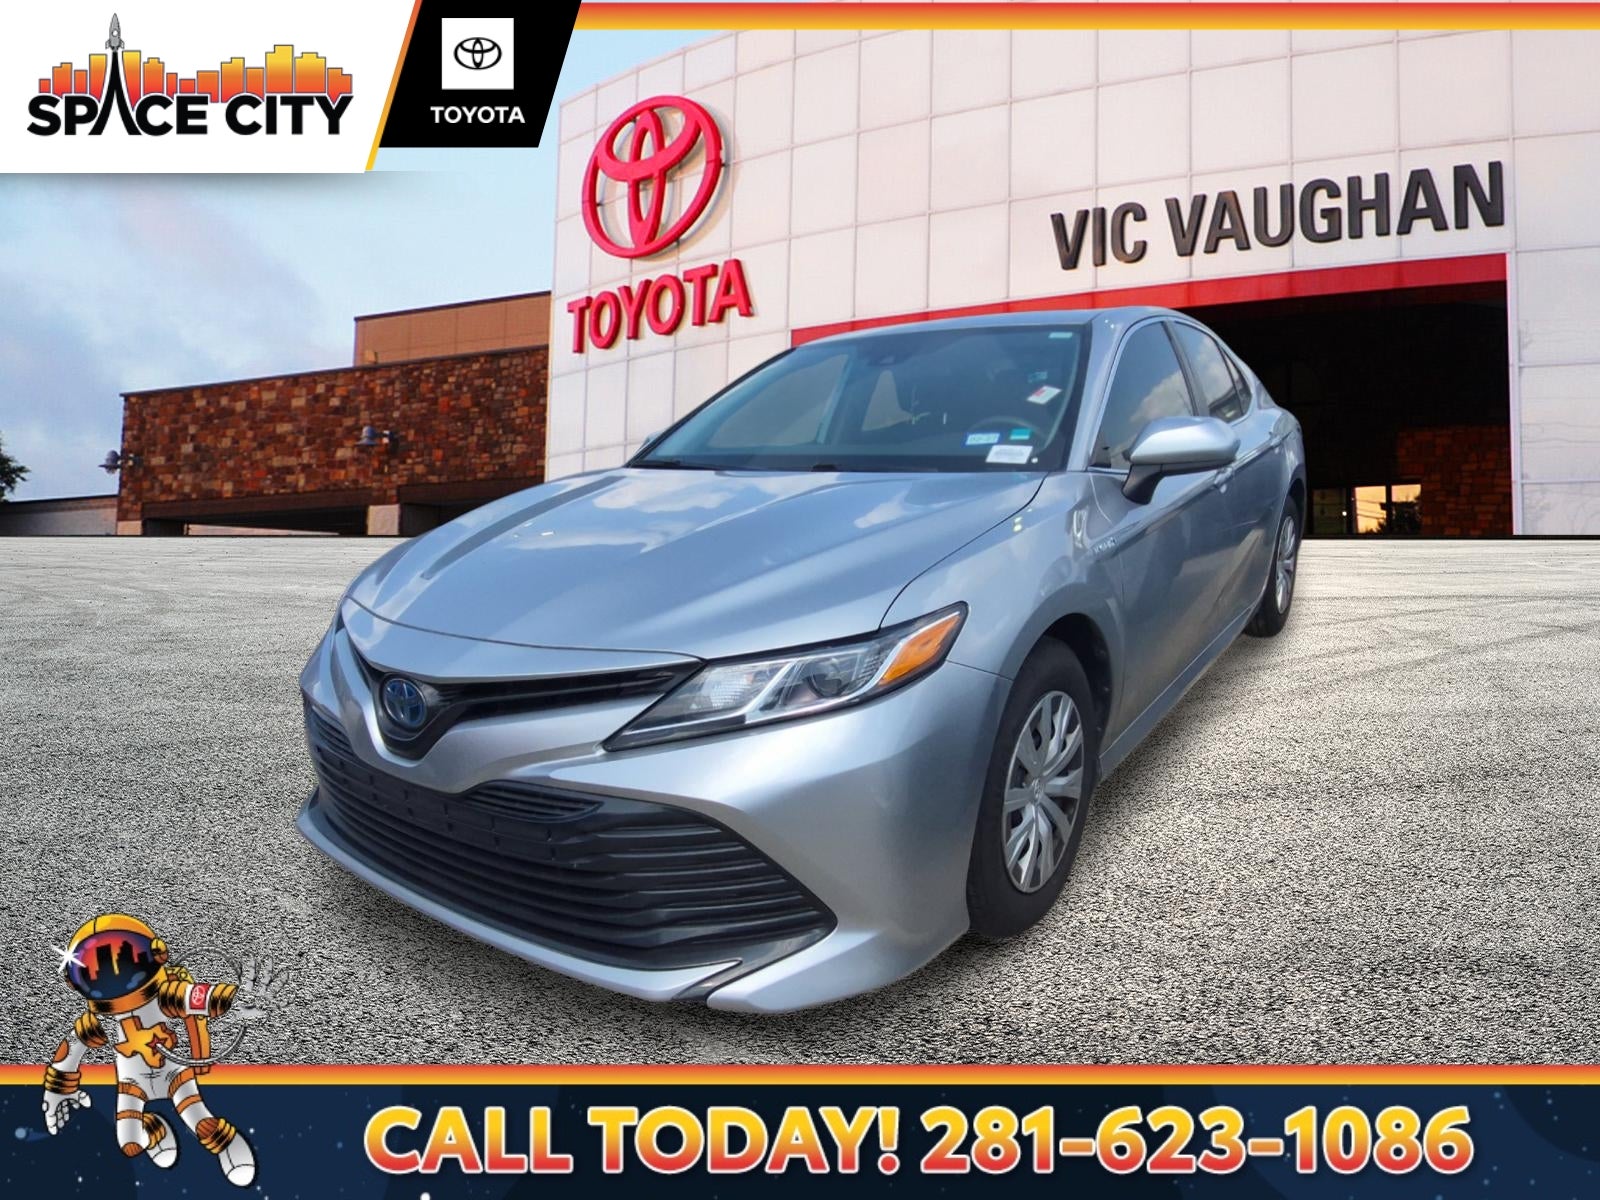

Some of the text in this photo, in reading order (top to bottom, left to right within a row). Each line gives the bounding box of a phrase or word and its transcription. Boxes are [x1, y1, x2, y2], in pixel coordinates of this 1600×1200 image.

[1050, 160, 1506, 270] VIC VAUGHAN
[567, 258, 754, 353] TOYOTA
